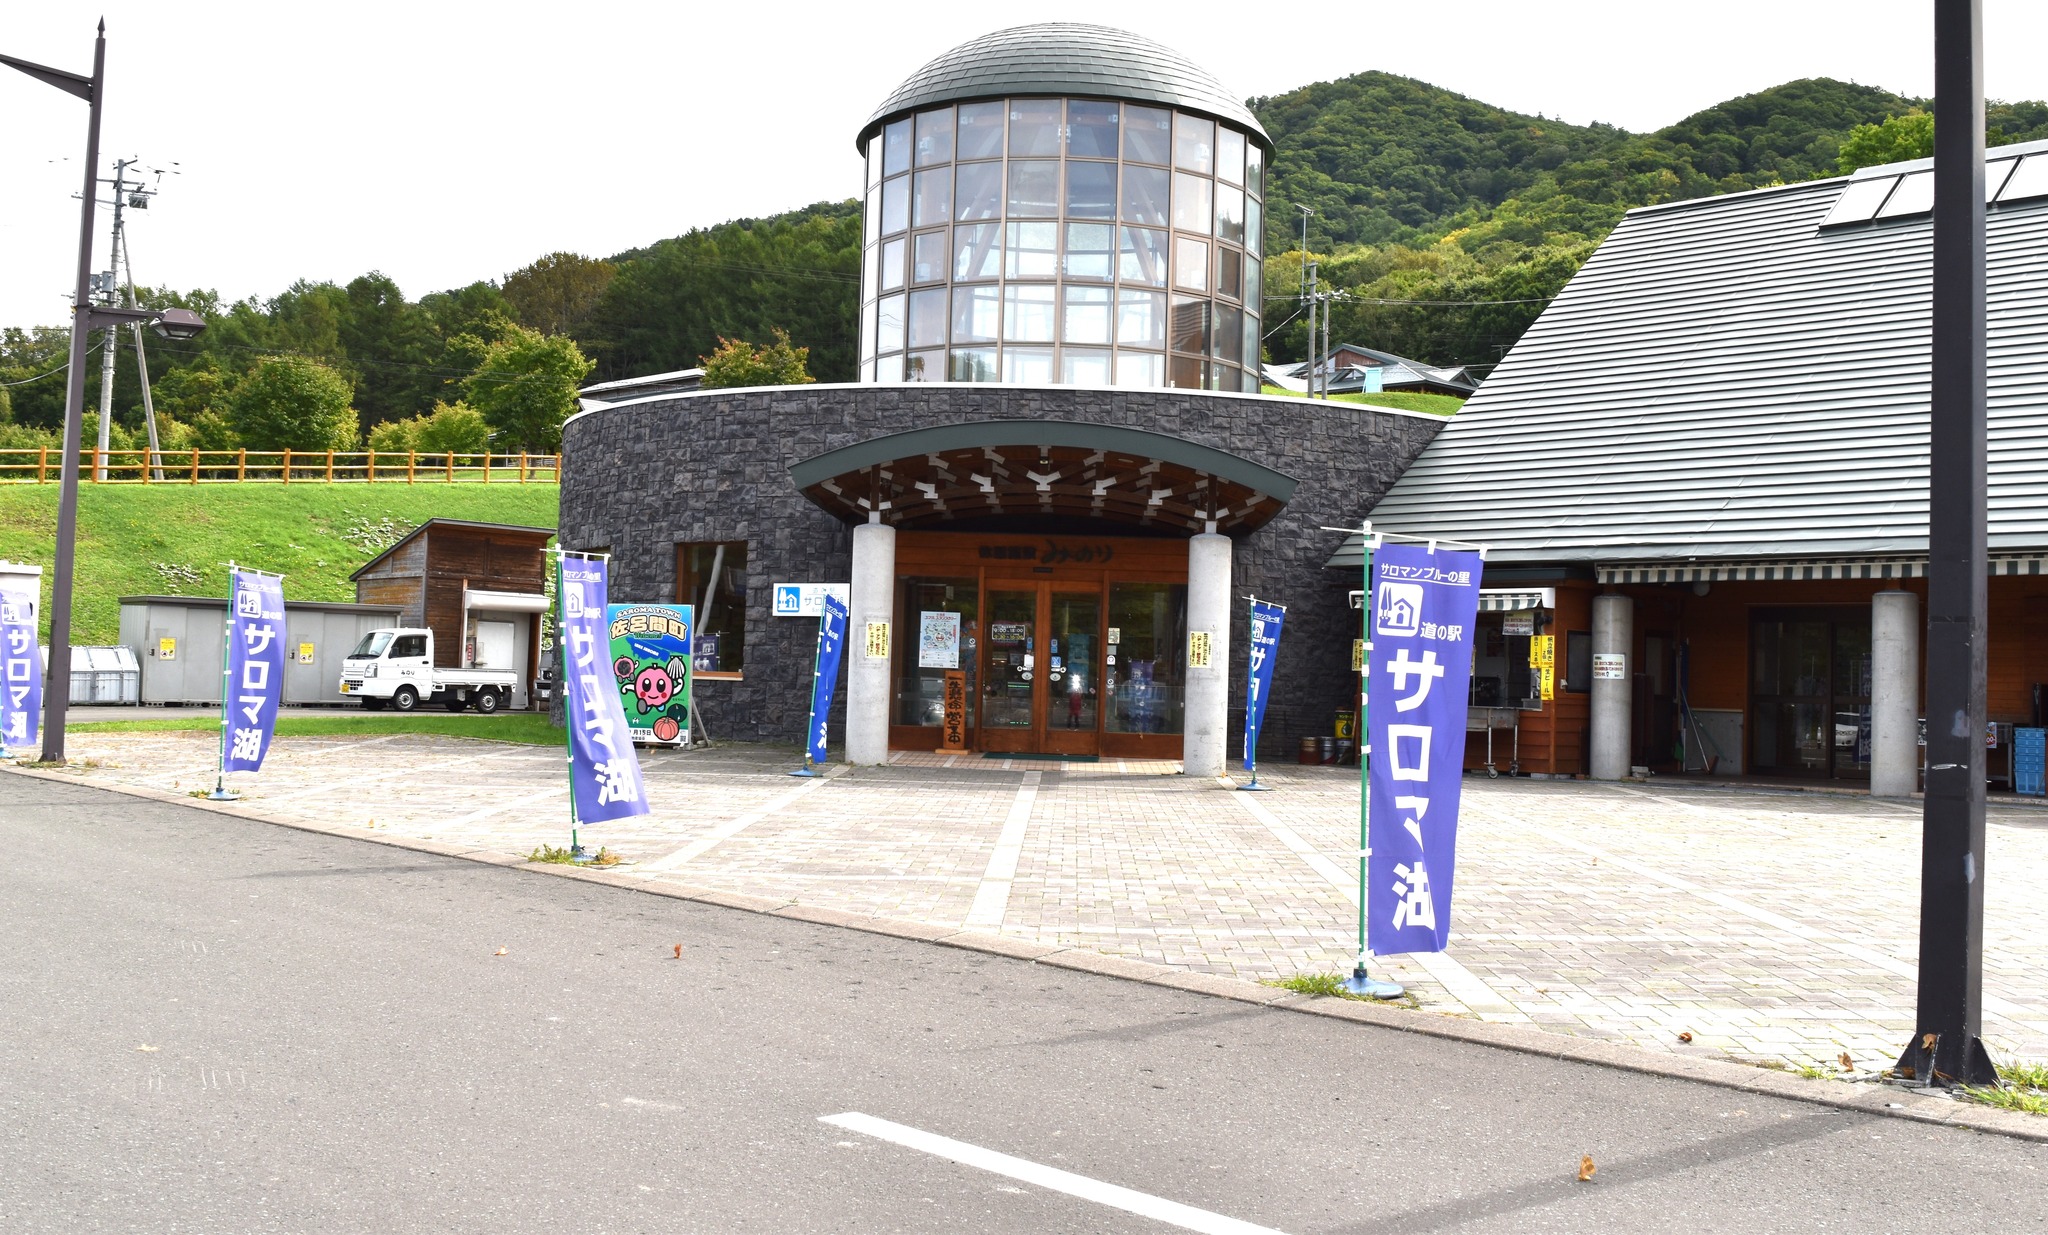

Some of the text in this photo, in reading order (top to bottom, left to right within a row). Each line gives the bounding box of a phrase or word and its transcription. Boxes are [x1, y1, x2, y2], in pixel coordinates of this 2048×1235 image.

[1381, 563, 1470, 583] サロマンブルーの里
[617, 607, 681, 619] SAROMA TOWN
[610, 615, 687, 640] 佐呂間町
[1420, 622, 1462, 641] 道の駅
[231, 623, 275, 761] サロマ湖
